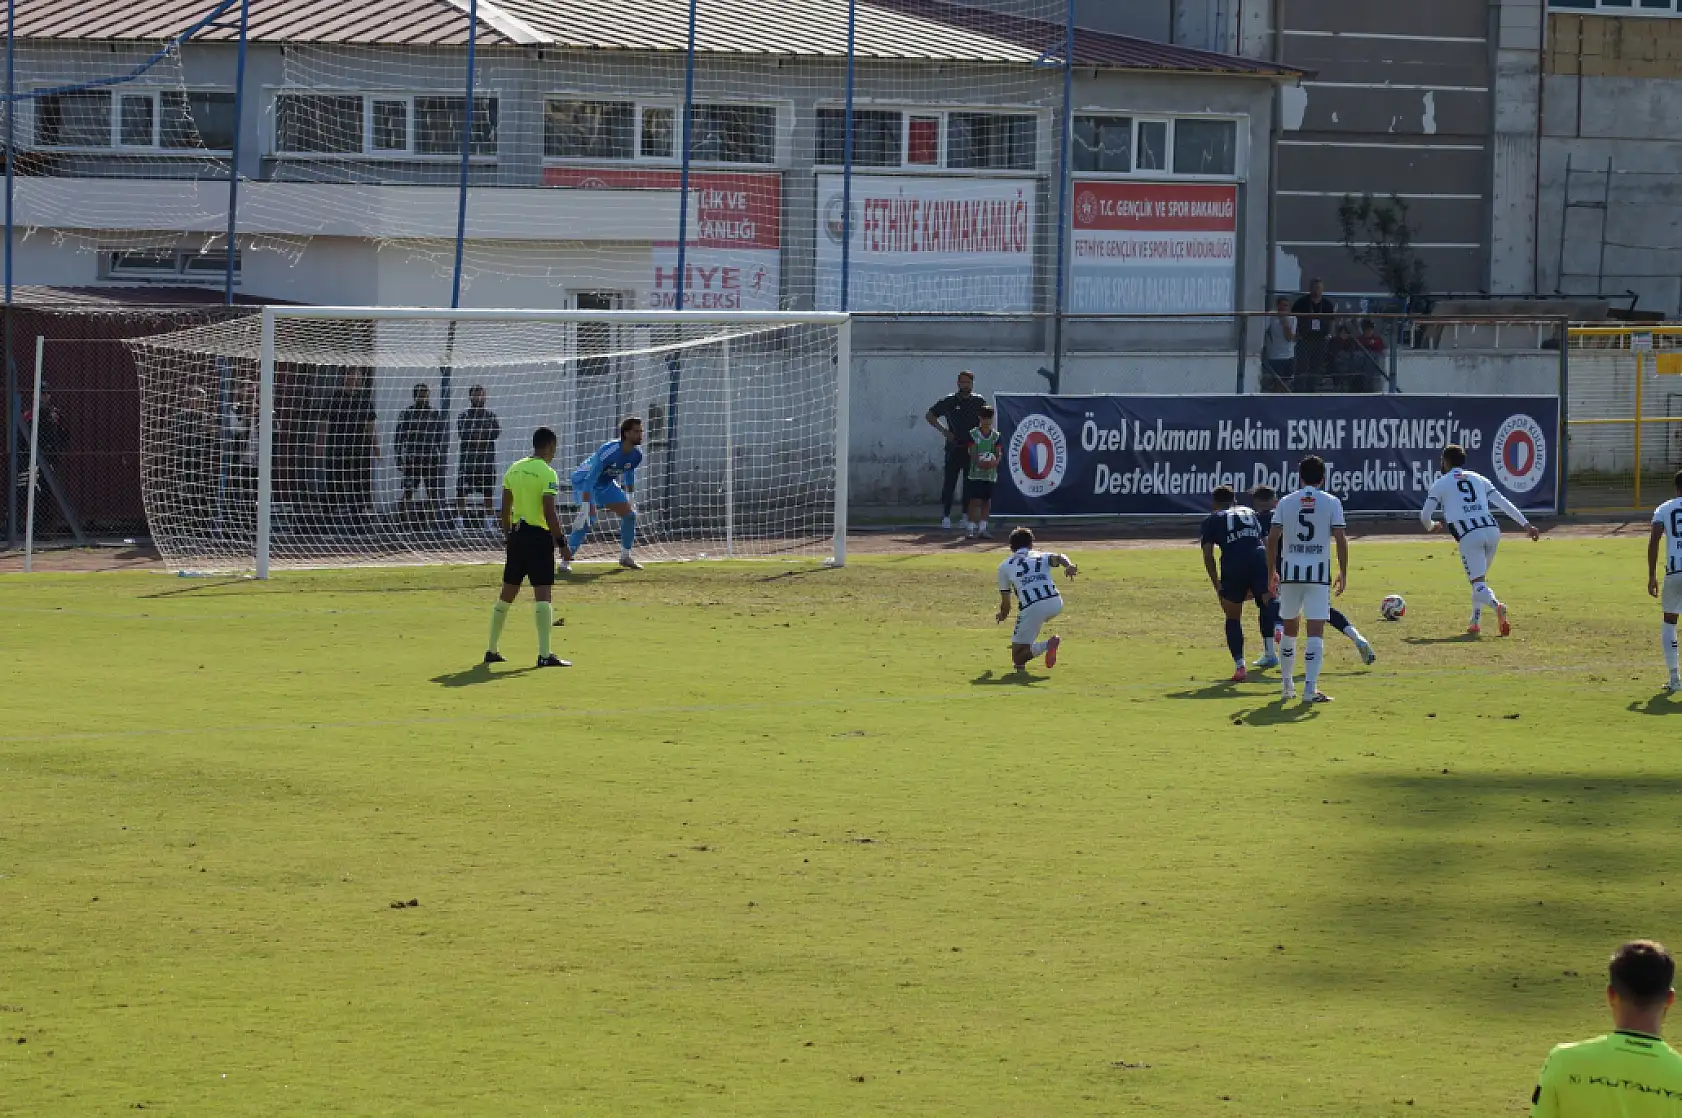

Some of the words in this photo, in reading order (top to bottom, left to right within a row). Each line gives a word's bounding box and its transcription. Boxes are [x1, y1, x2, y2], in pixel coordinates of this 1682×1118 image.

[727, 191, 749, 210] VE
[1100, 199, 1116, 217] T.C.
[1117, 196, 1153, 221] GENÇLİK
[1155, 200, 1167, 218] VE
[1168, 201, 1189, 218] SPOR
[1191, 198, 1234, 218] BAKANLIĞI
[863, 186, 920, 252] FETHİYE
[922, 187, 1028, 253] KAYMAKAMLIĞI
[1075, 235, 1105, 259] FETHİYE
[655, 263, 741, 289] HİYE
[650, 289, 741, 308] OMPLEKSİ
[1081, 411, 1128, 451] Özel
[1133, 418, 1212, 451] Lokman
[1217, 417, 1281, 451] Hekim
[1287, 418, 1347, 450] ESNAF
[1094, 460, 1247, 495] Desteklerinden
[1253, 460, 1300, 494] Dola
[1323, 459, 1406, 500] Teşekkür
[1457, 480, 1477, 503] 9
[1297, 508, 1315, 542] 5
